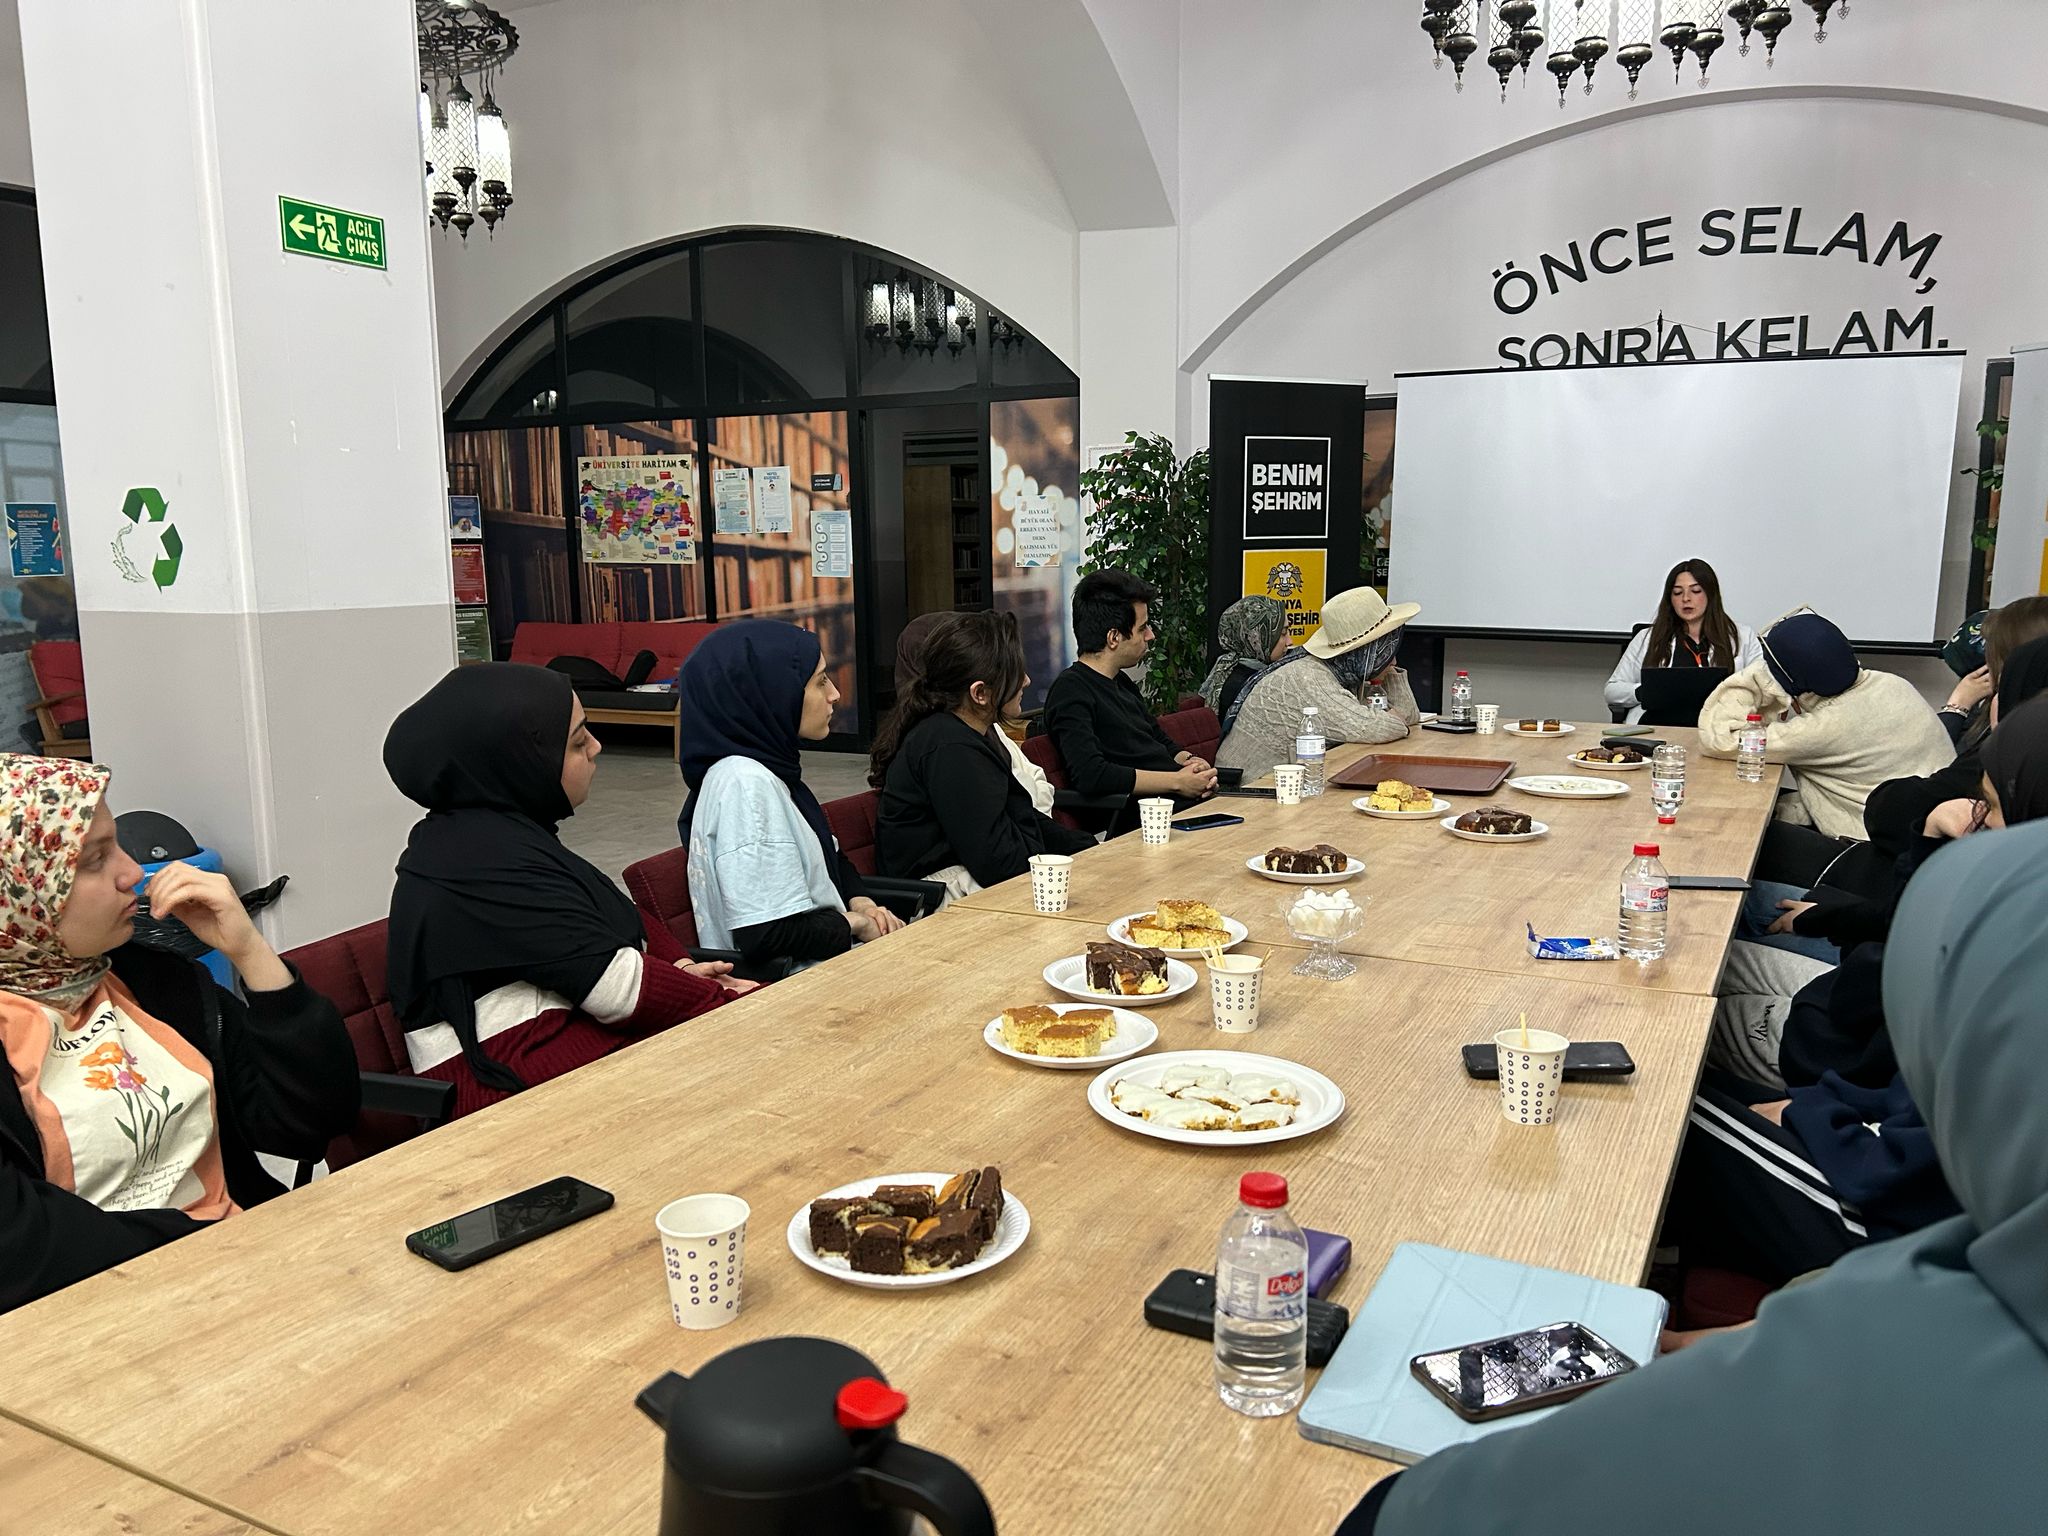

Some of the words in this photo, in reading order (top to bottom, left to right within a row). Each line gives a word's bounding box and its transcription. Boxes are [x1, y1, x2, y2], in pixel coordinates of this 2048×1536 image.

[346, 237, 379, 261] ÇIKIŞ
[1492, 216, 1675, 315] ÖNCE
[1698, 206, 1943, 294] SELAM,
[1498, 324, 1696, 369] SONRA
[1716, 306, 1949, 359] KELAM.
[1285, 599, 1302, 609] NYA
[1287, 609, 1320, 627] ŞEHİR
